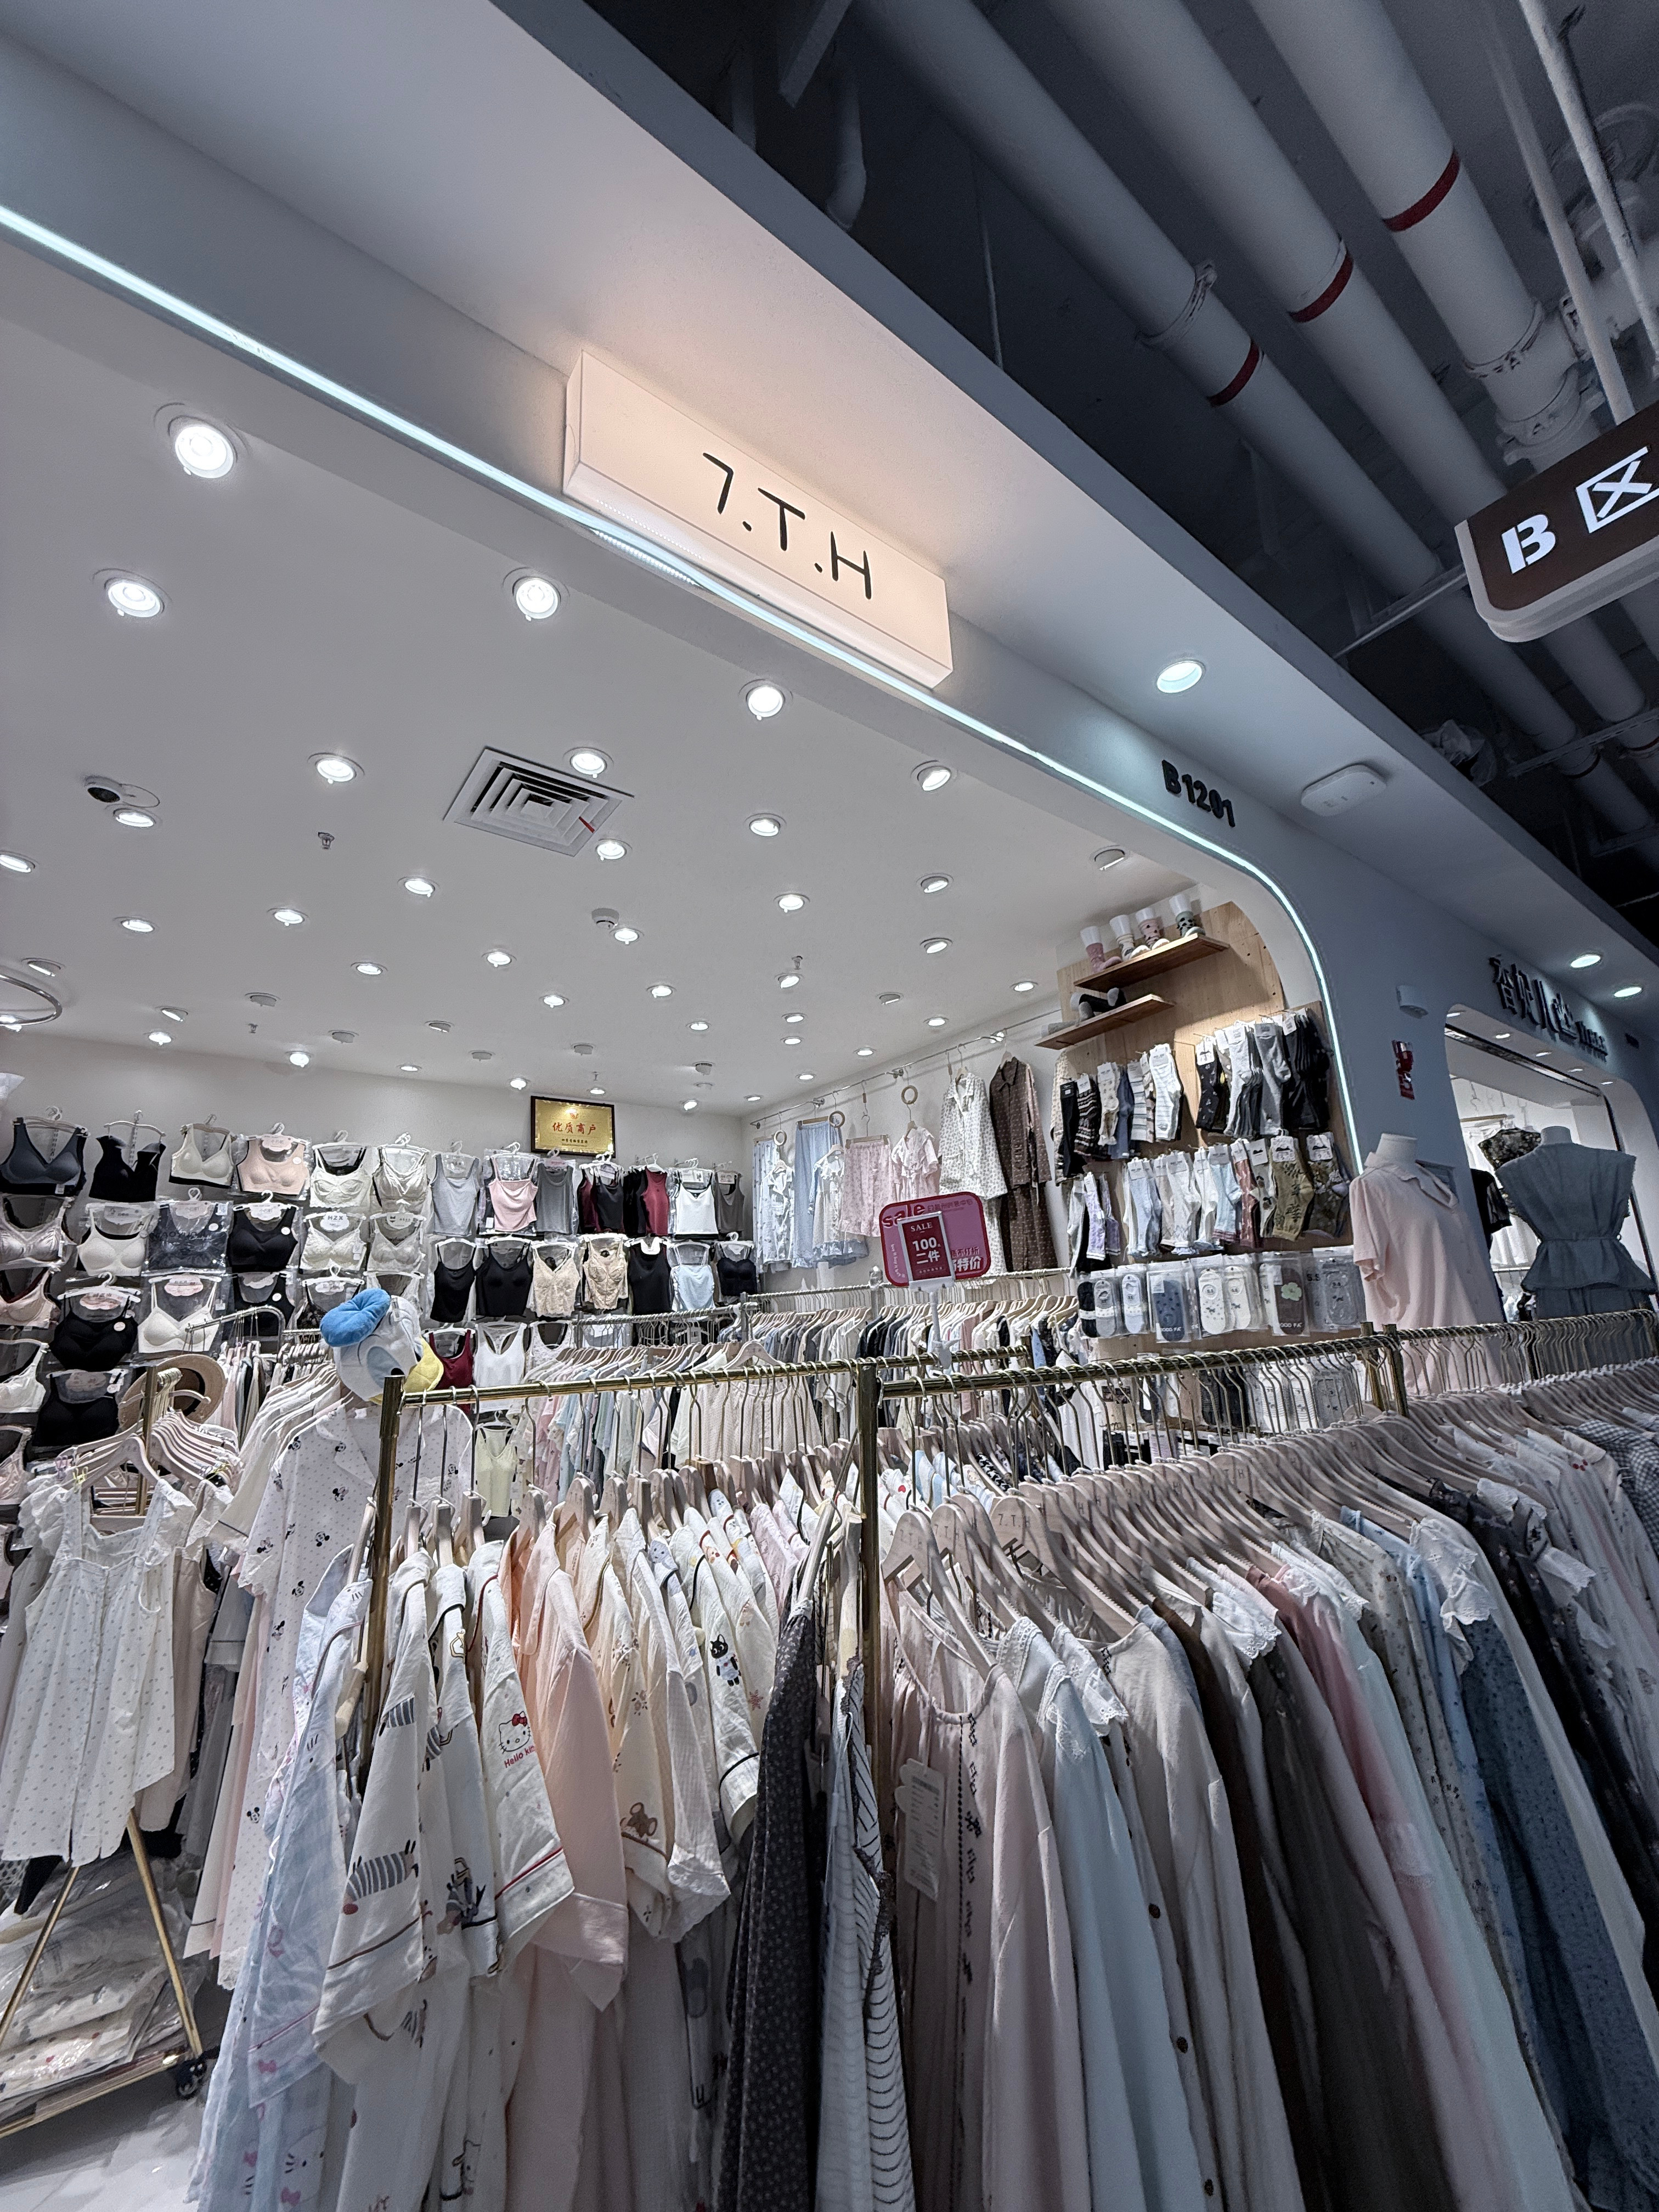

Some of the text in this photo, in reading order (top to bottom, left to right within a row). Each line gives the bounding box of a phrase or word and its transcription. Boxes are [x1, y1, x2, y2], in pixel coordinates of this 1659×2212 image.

[702, 452, 872, 600] 7.T.H
[1161, 759, 1235, 827] B1201
[552, 1122, 596, 1135] 优质商户
[911, 1222, 933, 1232] SALE
[916, 1250, 940, 1264] 二件
[504, 1752, 523, 1768] Hello
